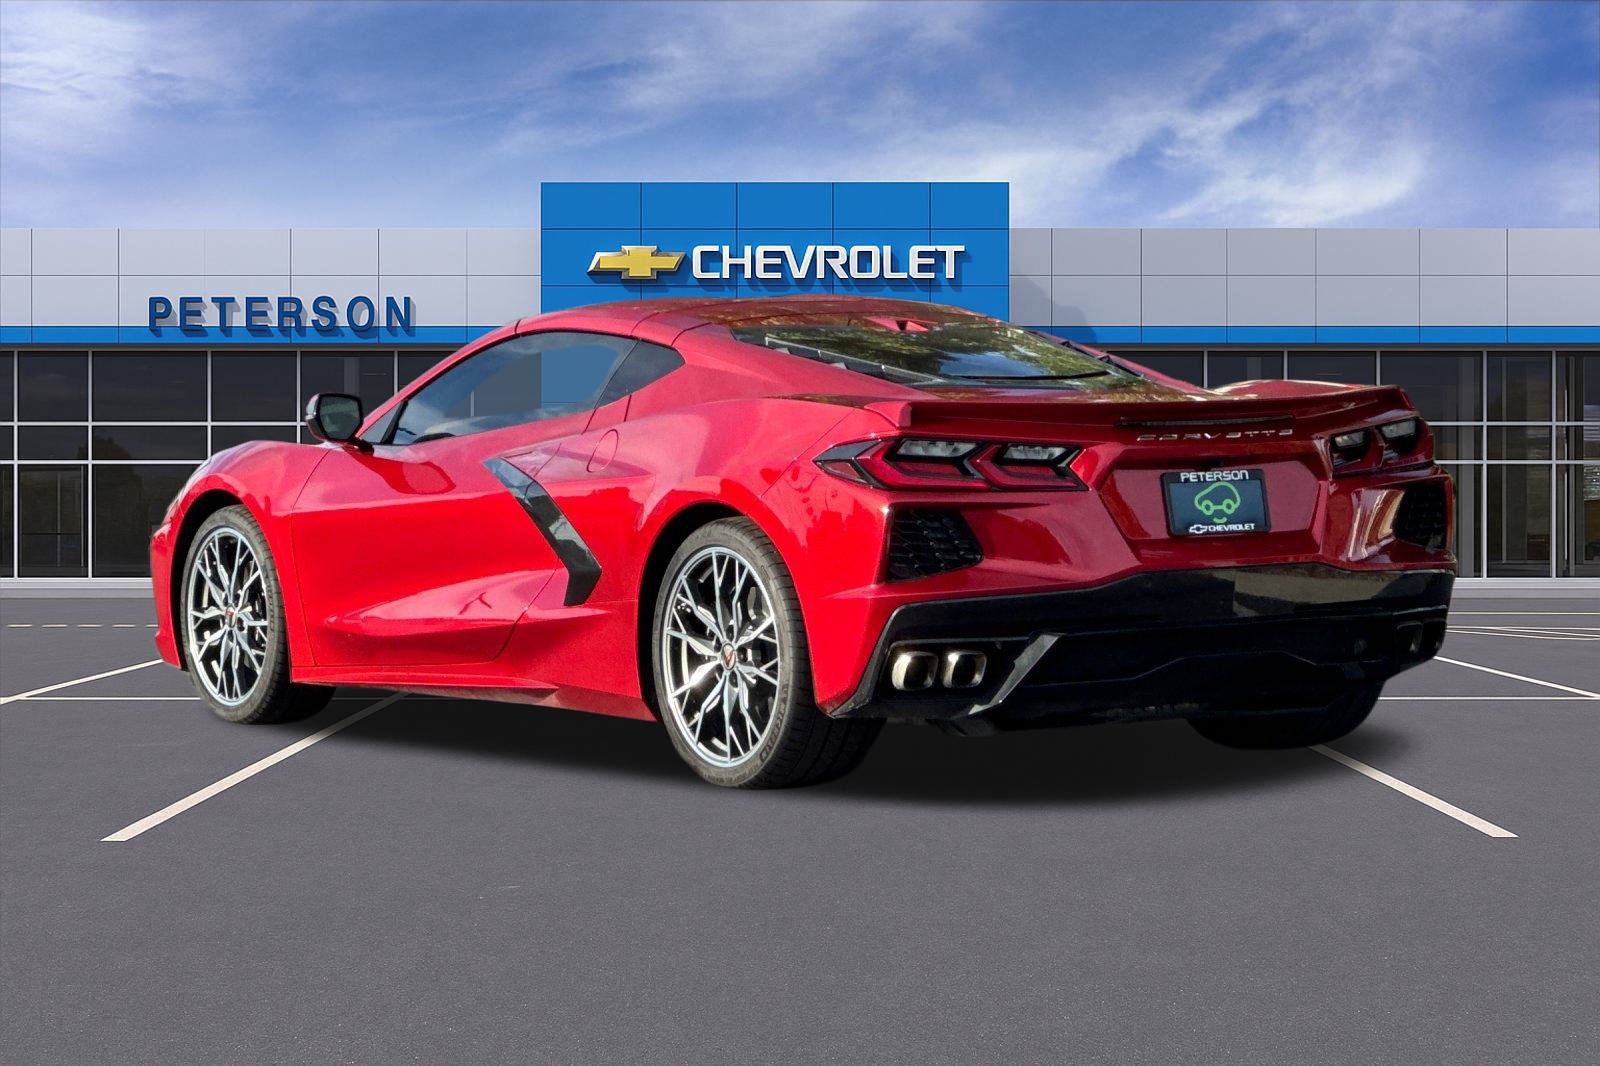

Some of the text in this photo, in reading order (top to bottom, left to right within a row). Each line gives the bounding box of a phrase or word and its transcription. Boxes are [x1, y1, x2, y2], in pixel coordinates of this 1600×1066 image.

[692, 245, 966, 280] CHEVROLET
[148, 295, 411, 332] PETERSON
[1180, 470, 1249, 482] PETERSON
[1208, 523, 1255, 532] CHEVROLET
